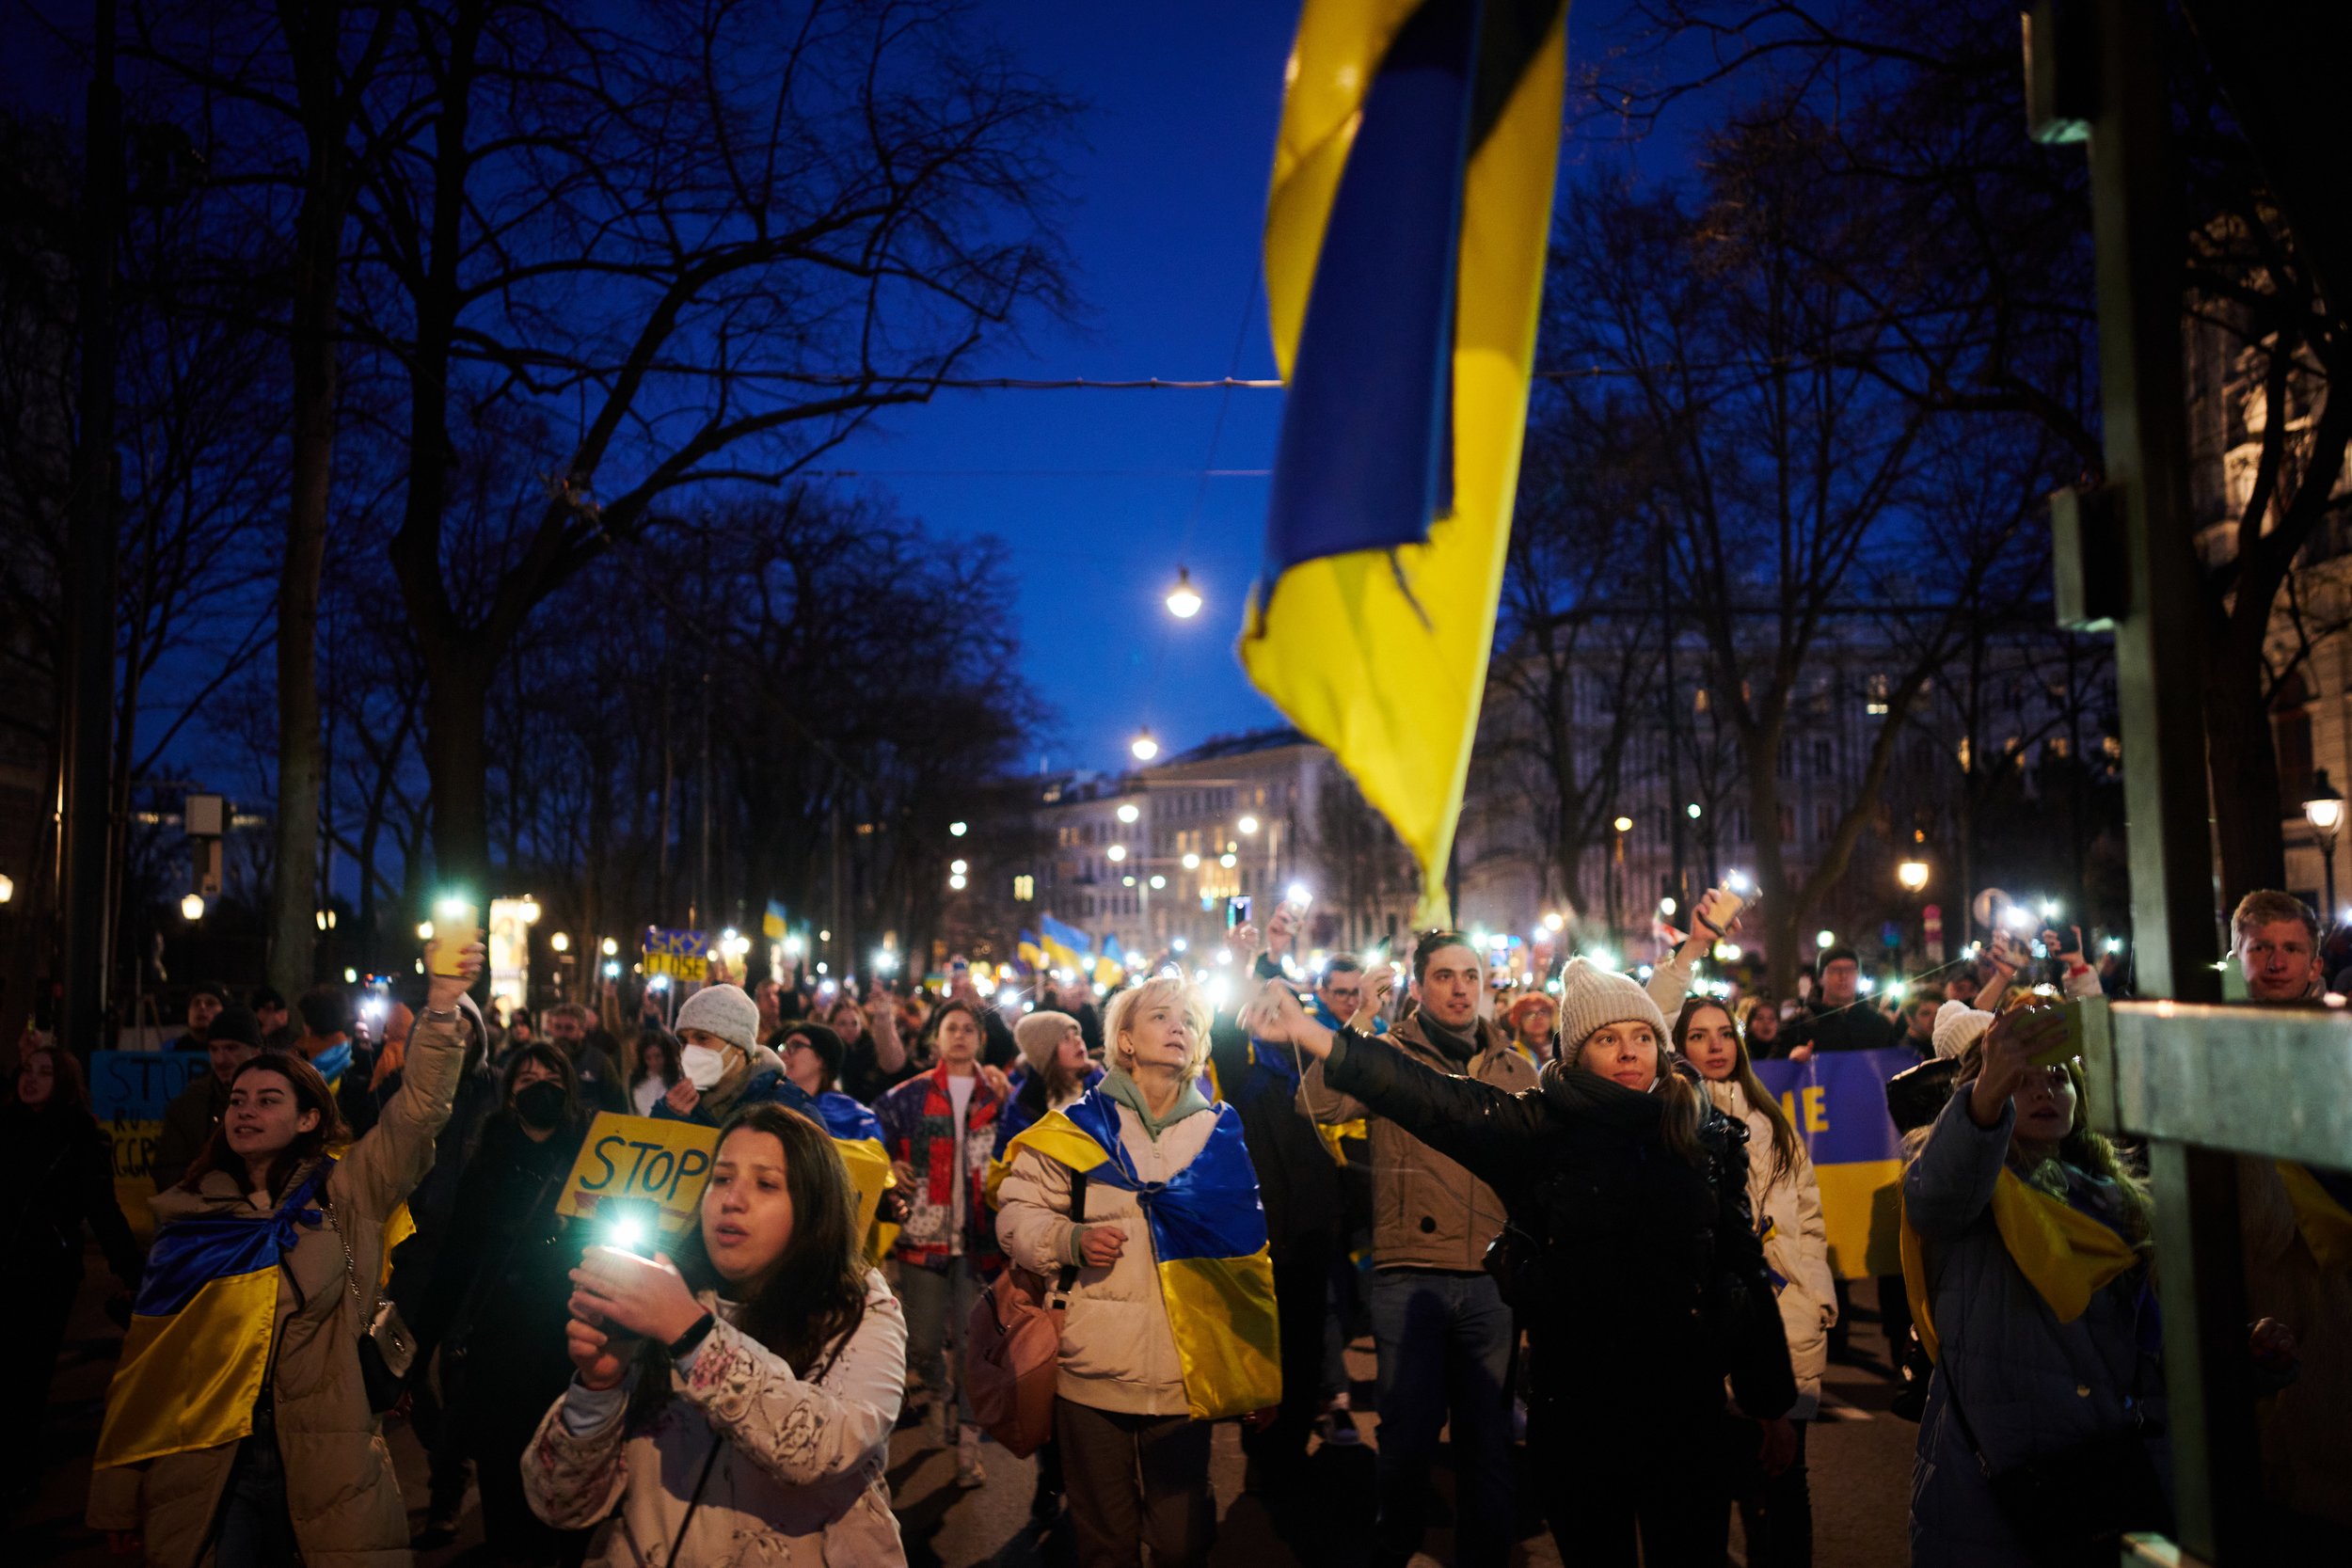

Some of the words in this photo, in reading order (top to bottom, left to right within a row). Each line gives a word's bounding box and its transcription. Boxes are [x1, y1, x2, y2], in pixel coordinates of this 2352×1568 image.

[651, 932, 705, 954] SKY
[108, 1057, 211, 1102] STOP
[580, 1135, 709, 1201] STOP
